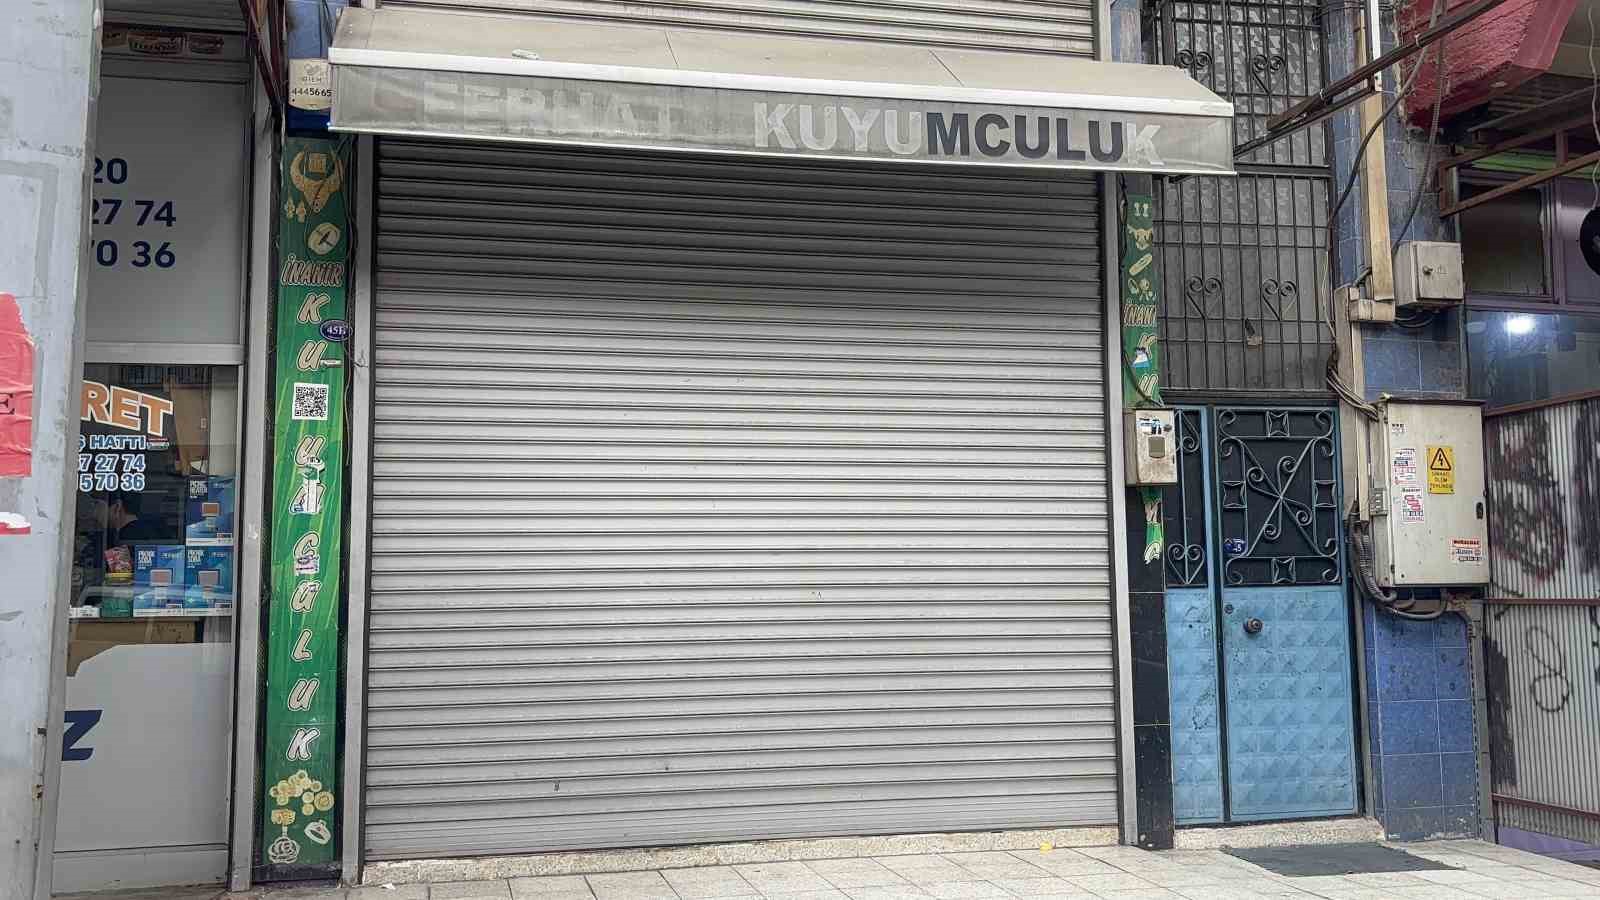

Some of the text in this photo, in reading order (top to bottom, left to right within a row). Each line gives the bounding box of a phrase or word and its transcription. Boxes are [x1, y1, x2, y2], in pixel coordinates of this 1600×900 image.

[753, 102, 1165, 166] KUYUMCULUK
[135, 199, 177, 227] 74
[91, 239, 176, 268] 0 36
[90, 435, 147, 450] HATTI
[95, 453, 119, 472] 27
[122, 454, 146, 472] 74
[95, 473, 119, 491] 70
[120, 473, 145, 491] 36
